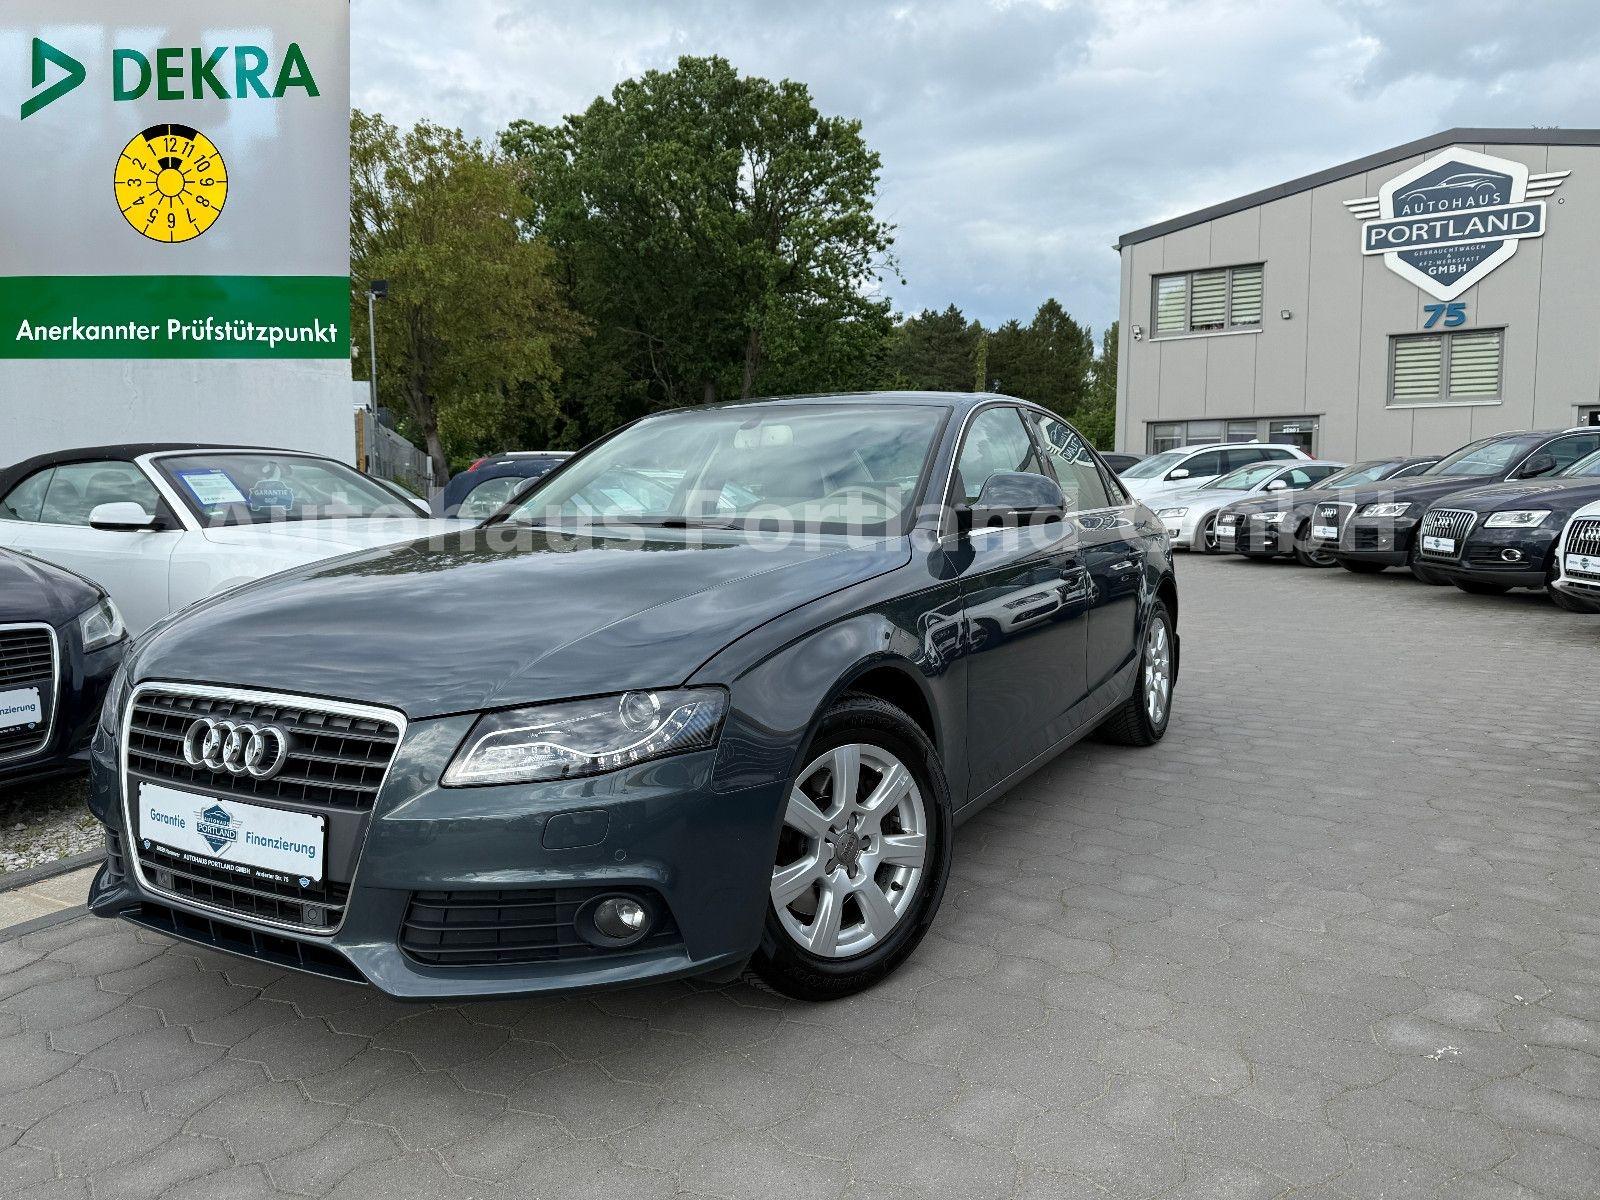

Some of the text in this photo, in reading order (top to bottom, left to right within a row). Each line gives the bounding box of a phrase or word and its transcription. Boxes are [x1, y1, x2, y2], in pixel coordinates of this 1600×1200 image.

[113, 42, 320, 101] DEKRA
[147, 143, 156, 156] 1
[164, 138, 177, 153] 12
[181, 141, 196, 158] 11
[132, 158, 146, 171] 2
[194, 154, 211, 173] 10
[127, 178, 142, 187] 3
[200, 177, 215, 187] 9
[132, 195, 146, 207] 4
[196, 195, 210, 207] 8
[1402, 194, 1501, 215] AUTOHAUS
[147, 208, 158, 224] 5
[186, 208, 197, 223] 7
[1370, 211, 1535, 246] PORTLAND
[1414, 244, 1486, 256] GEBRAUCHTWAGEN
[1428, 264, 1467, 274] GMBH
[1424, 303, 1466, 329] 75
[15, 317, 338, 348] Anerkannter Prüfstützpunkt
[150, 808, 186, 829] Garantie
[198, 823, 236, 838] PORTLAND
[245, 831, 316, 858] Finanzierung
[183, 853, 208, 866] AUTOHAUS
[208, 859, 235, 872] PORTLAND
